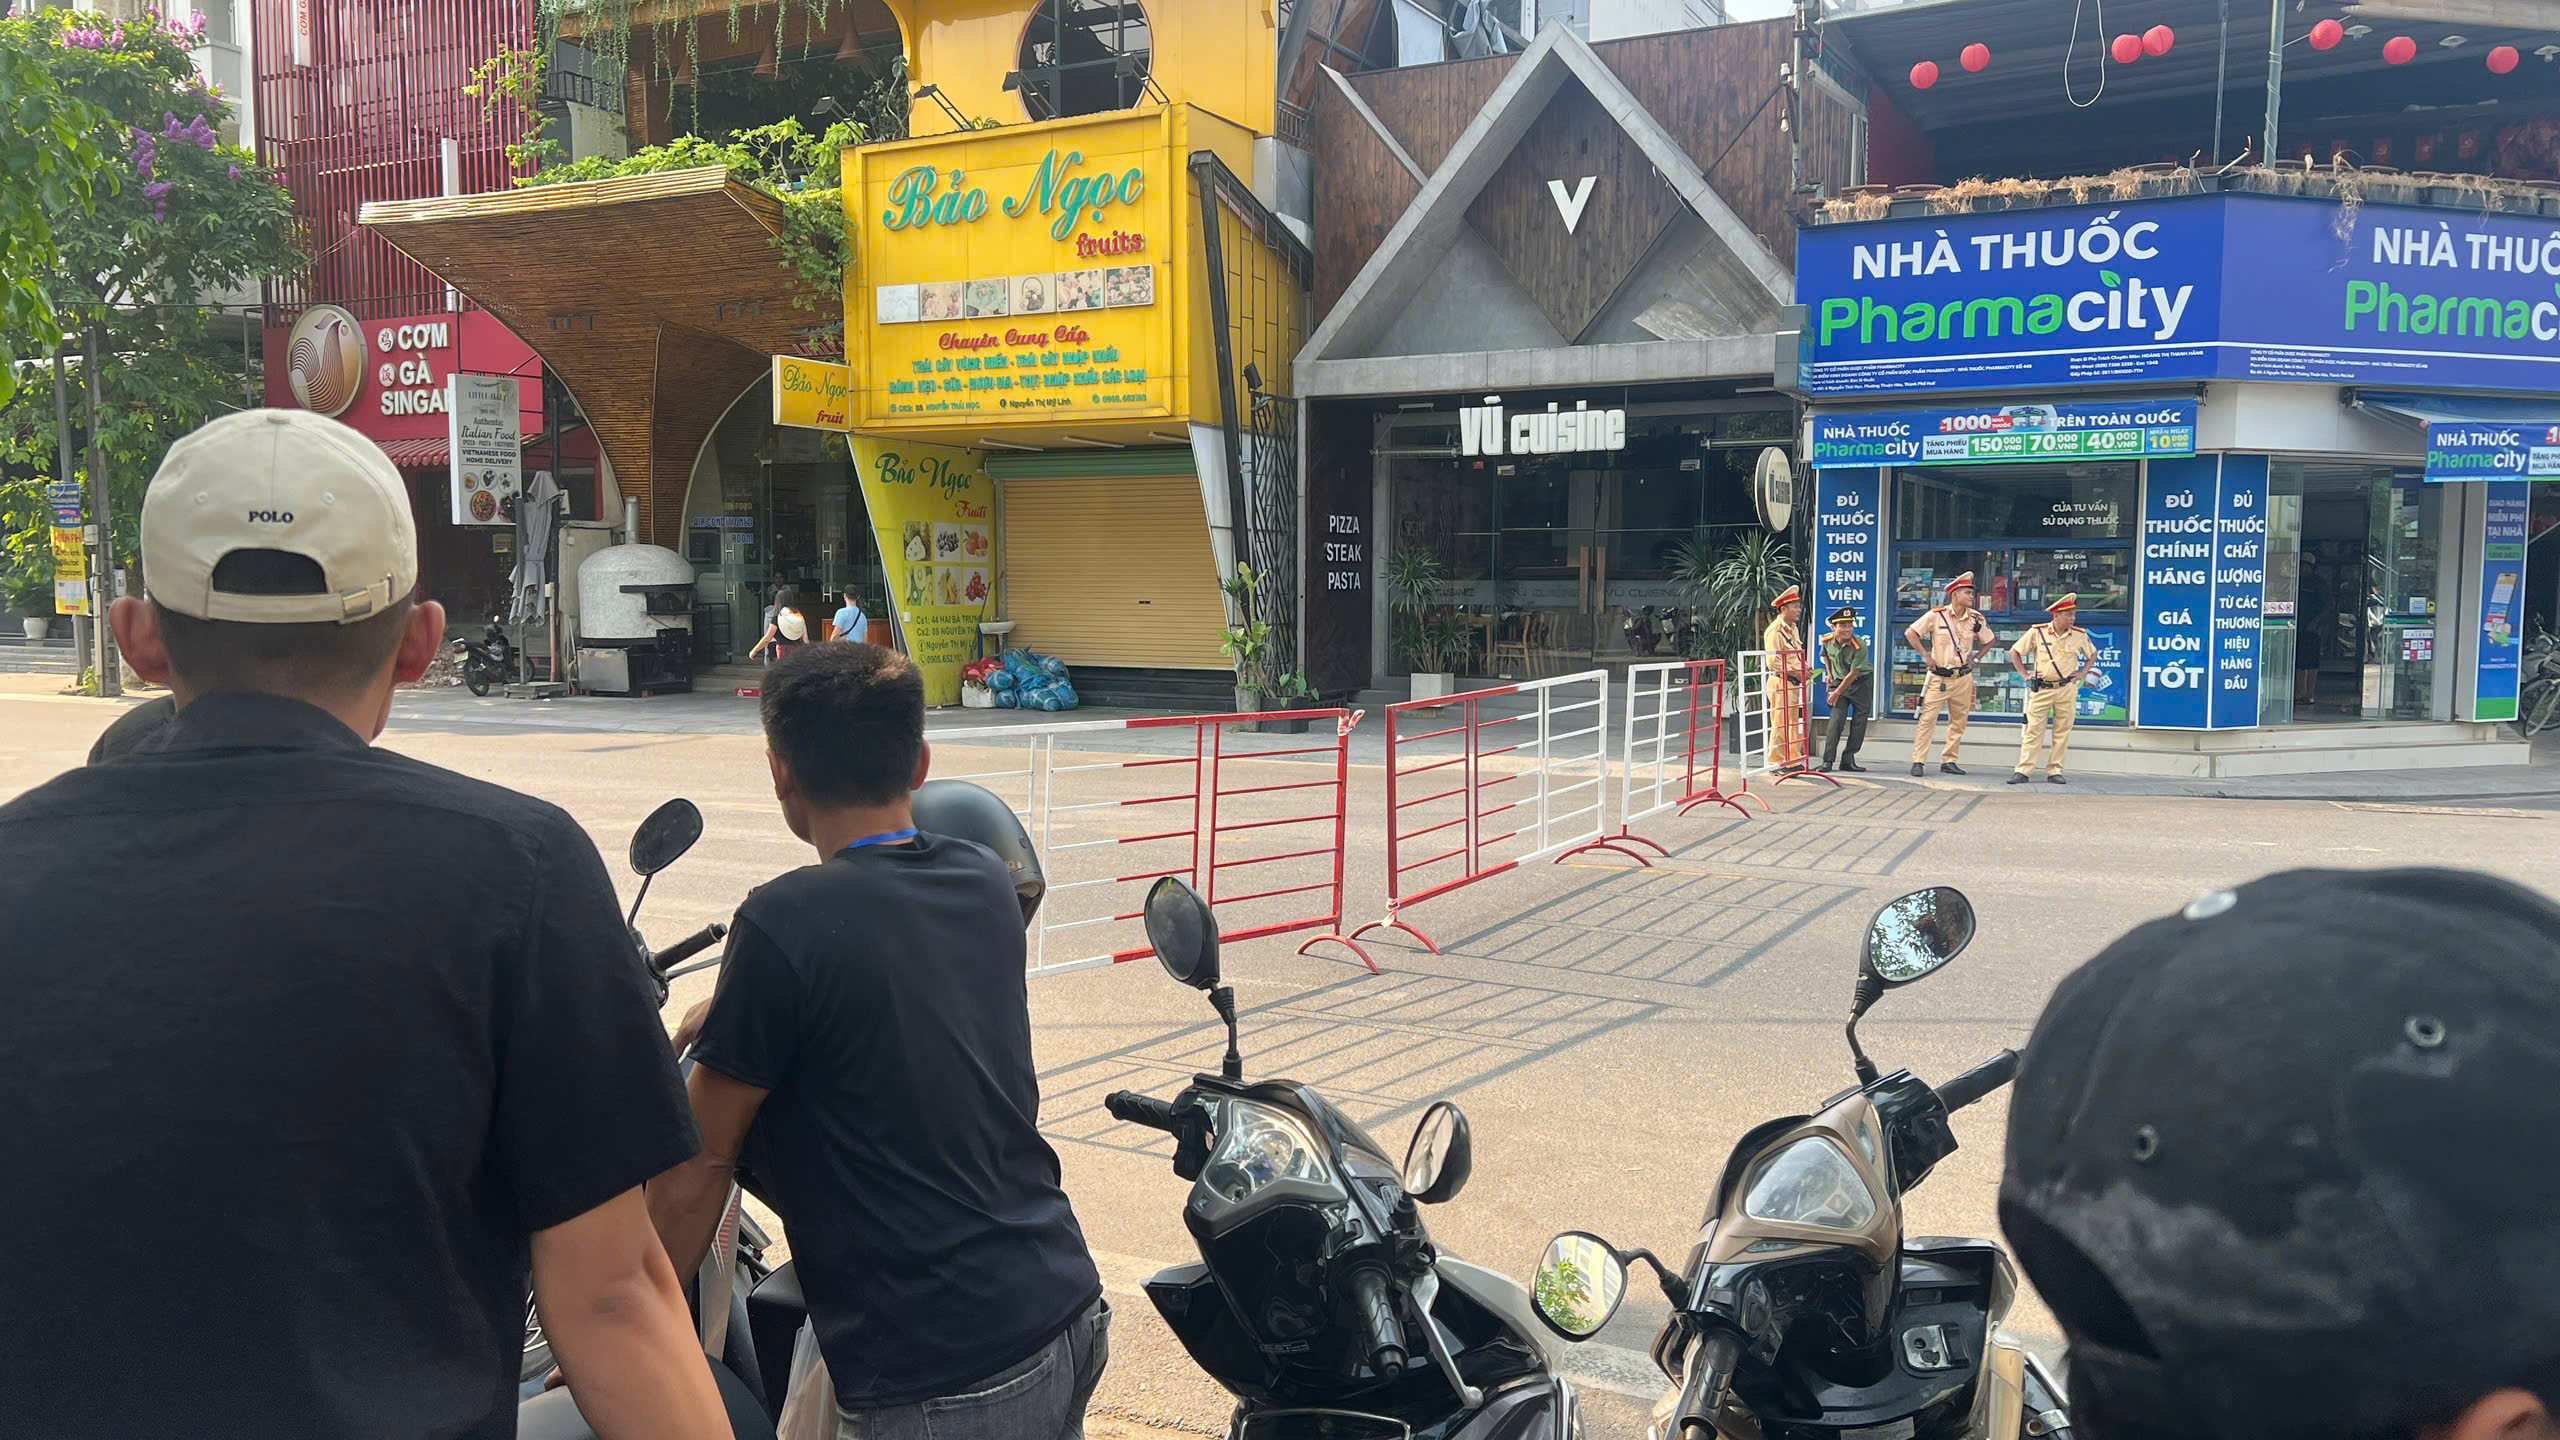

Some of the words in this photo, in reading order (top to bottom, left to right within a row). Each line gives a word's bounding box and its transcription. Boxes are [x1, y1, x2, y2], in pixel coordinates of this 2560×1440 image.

[882, 164, 987, 231] Bảo
[1002, 148, 1144, 241] Ngọc
[1547, 176, 1597, 236] V
[1076, 230, 1144, 257] fruits
[1853, 230, 1961, 280] NHÀ
[1971, 210, 2160, 271] THUỐC
[2373, 221, 2458, 268] NHÀ
[1820, 270, 2194, 346] Pharmacity
[2345, 280, 2560, 341] Pharmac
[398, 322, 449, 350] CƠM
[939, 333, 1000, 351] Chuyên
[1005, 328, 1049, 347] Cung
[1054, 325, 1090, 346] Cấp
[400, 352, 434, 386] GÀ
[784, 364, 812, 392] Bảo
[816, 371, 847, 407] Ngọc
[473, 417, 504, 426] Authentic
[816, 409, 844, 424] fruit
[1942, 414, 1992, 431] 1000
[2050, 414, 2086, 427] TRÊN
[2089, 412, 2131, 426] TOÀN
[2135, 408, 2181, 424] QUỐC
[461, 425, 492, 440] Italian
[494, 427, 516, 441] Food
[1511, 400, 1625, 455] cuisine
[1823, 424, 1856, 439] NHÀ
[1858, 421, 1911, 438] THUỐC
[2437, 430, 2468, 446] NHÀ
[2470, 428, 2520, 446] THUỐC
[462, 449, 498, 458] VIETNAMESE
[500, 450, 516, 458] FOOD
[1814, 437, 1920, 459] Pharmacity
[1944, 446, 1964, 455] HÀNG
[2427, 448, 2526, 472] Pharmacity
[875, 453, 915, 484] Bảo
[920, 457, 972, 501] Ngọc
[1836, 491, 1859, 507] ĐỦ
[2052, 501, 2072, 512] CỬA
[2088, 500, 2108, 512] VẤN
[2165, 490, 2194, 508] ĐỦ
[2233, 490, 2253, 508] ĐỦ
[248, 510, 294, 524] POLO
[1329, 514, 1360, 534] PIZZA
[1821, 510, 1875, 526] THUỐC
[2042, 514, 2056, 526] SỬ
[2057, 517, 2085, 527] DỤNG
[2086, 514, 2120, 525] THUỐC
[2146, 514, 2212, 533] THUỐC
[2219, 515, 2264, 533] THUỐC
[2488, 509, 2508, 522] MIỄN
[2510, 511, 2524, 522] PHÍ
[1826, 532, 1868, 544] THEO
[2488, 527, 2502, 539] TẠI
[2502, 525, 2523, 536] NHÀ
[1326, 543, 1362, 562] STEAK
[1829, 550, 1864, 563] ĐƠN
[2146, 540, 2210, 558] CHÍNH
[2224, 540, 2258, 558] CHẤT
[1328, 572, 1361, 590] PASTA
[1826, 568, 1867, 585] BỆNH
[2148, 568, 2206, 584] HÃNG
[2217, 568, 2262, 587] LƯỢNG
[1828, 586, 1863, 604] VIỆN
[2220, 595, 2234, 609] TỪ
[2236, 594, 2258, 609] CÁC
[2158, 608, 2192, 625] GIÁ
[2216, 617, 2260, 630] THƯƠNG
[2148, 634, 2200, 650] LUÔN
[2224, 636, 2250, 652] HIỆU
[2221, 656, 2252, 670] HÀNG
[2142, 659, 2204, 688] TỐT
[2224, 675, 2248, 690] ĐẦU
